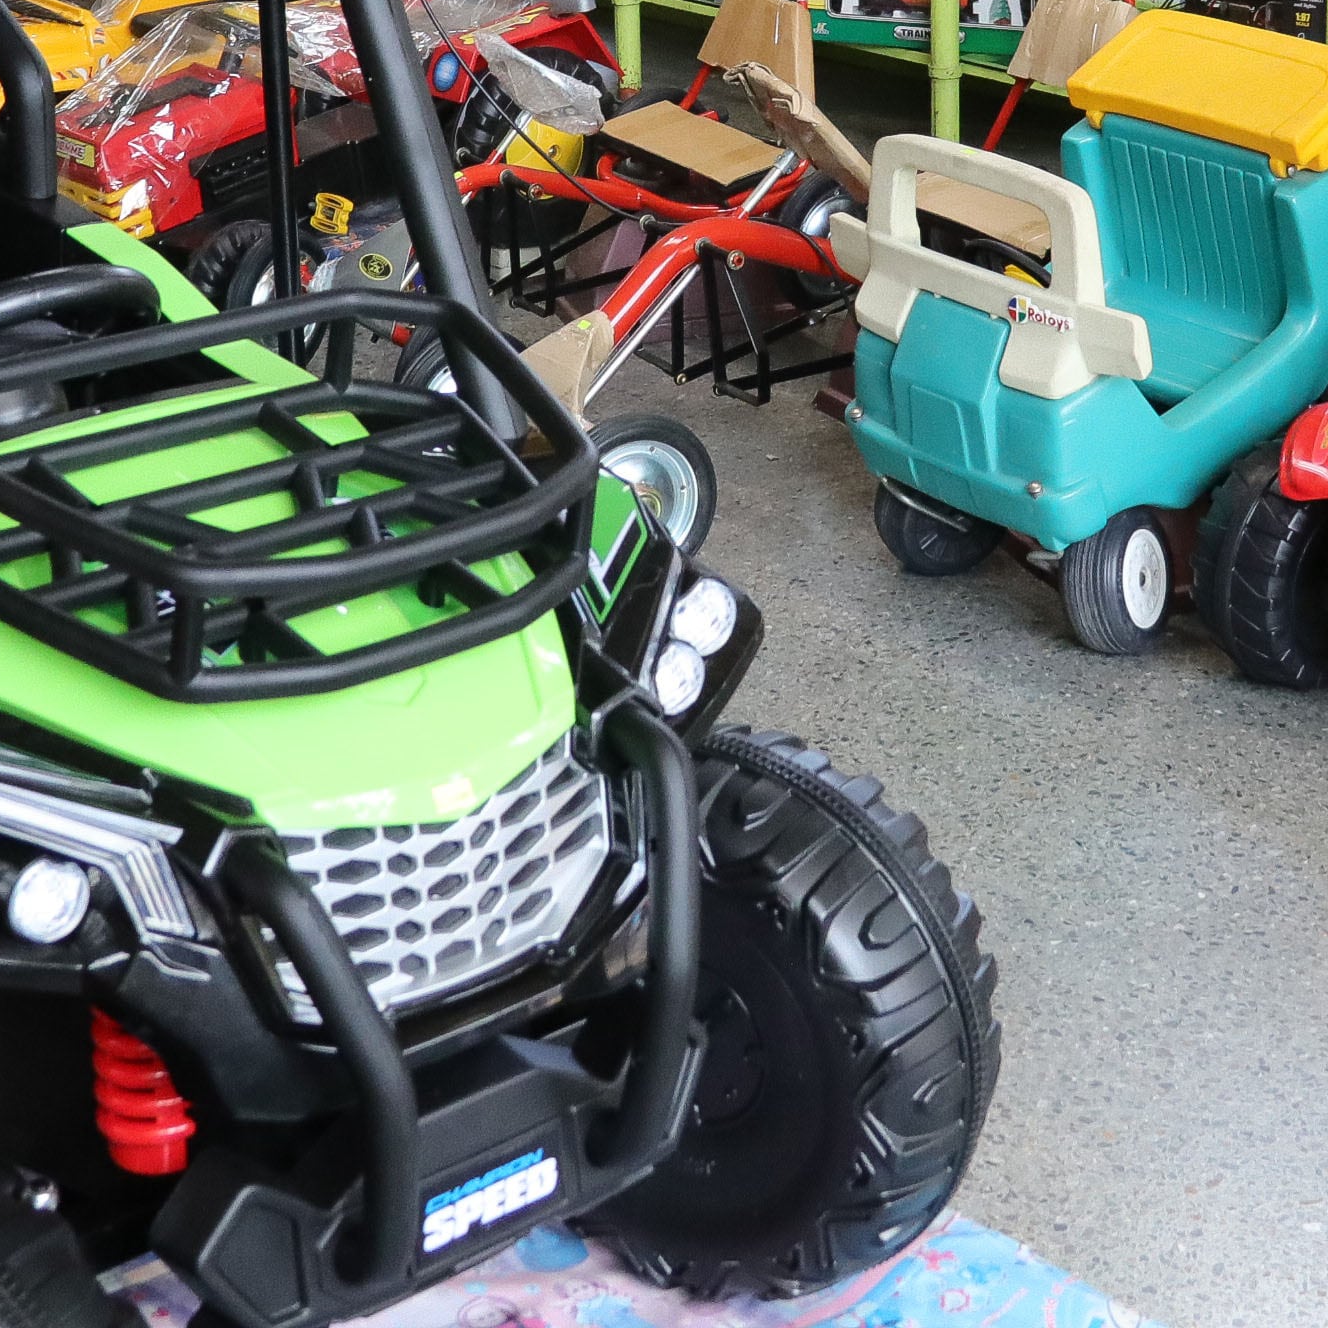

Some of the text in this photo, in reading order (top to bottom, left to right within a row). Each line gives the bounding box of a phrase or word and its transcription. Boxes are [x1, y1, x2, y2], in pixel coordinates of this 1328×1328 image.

[1296, 12, 1311, 23] 1:87
[1027, 306, 1070, 332] Rotoys
[423, 1157, 557, 1252] SPEED
